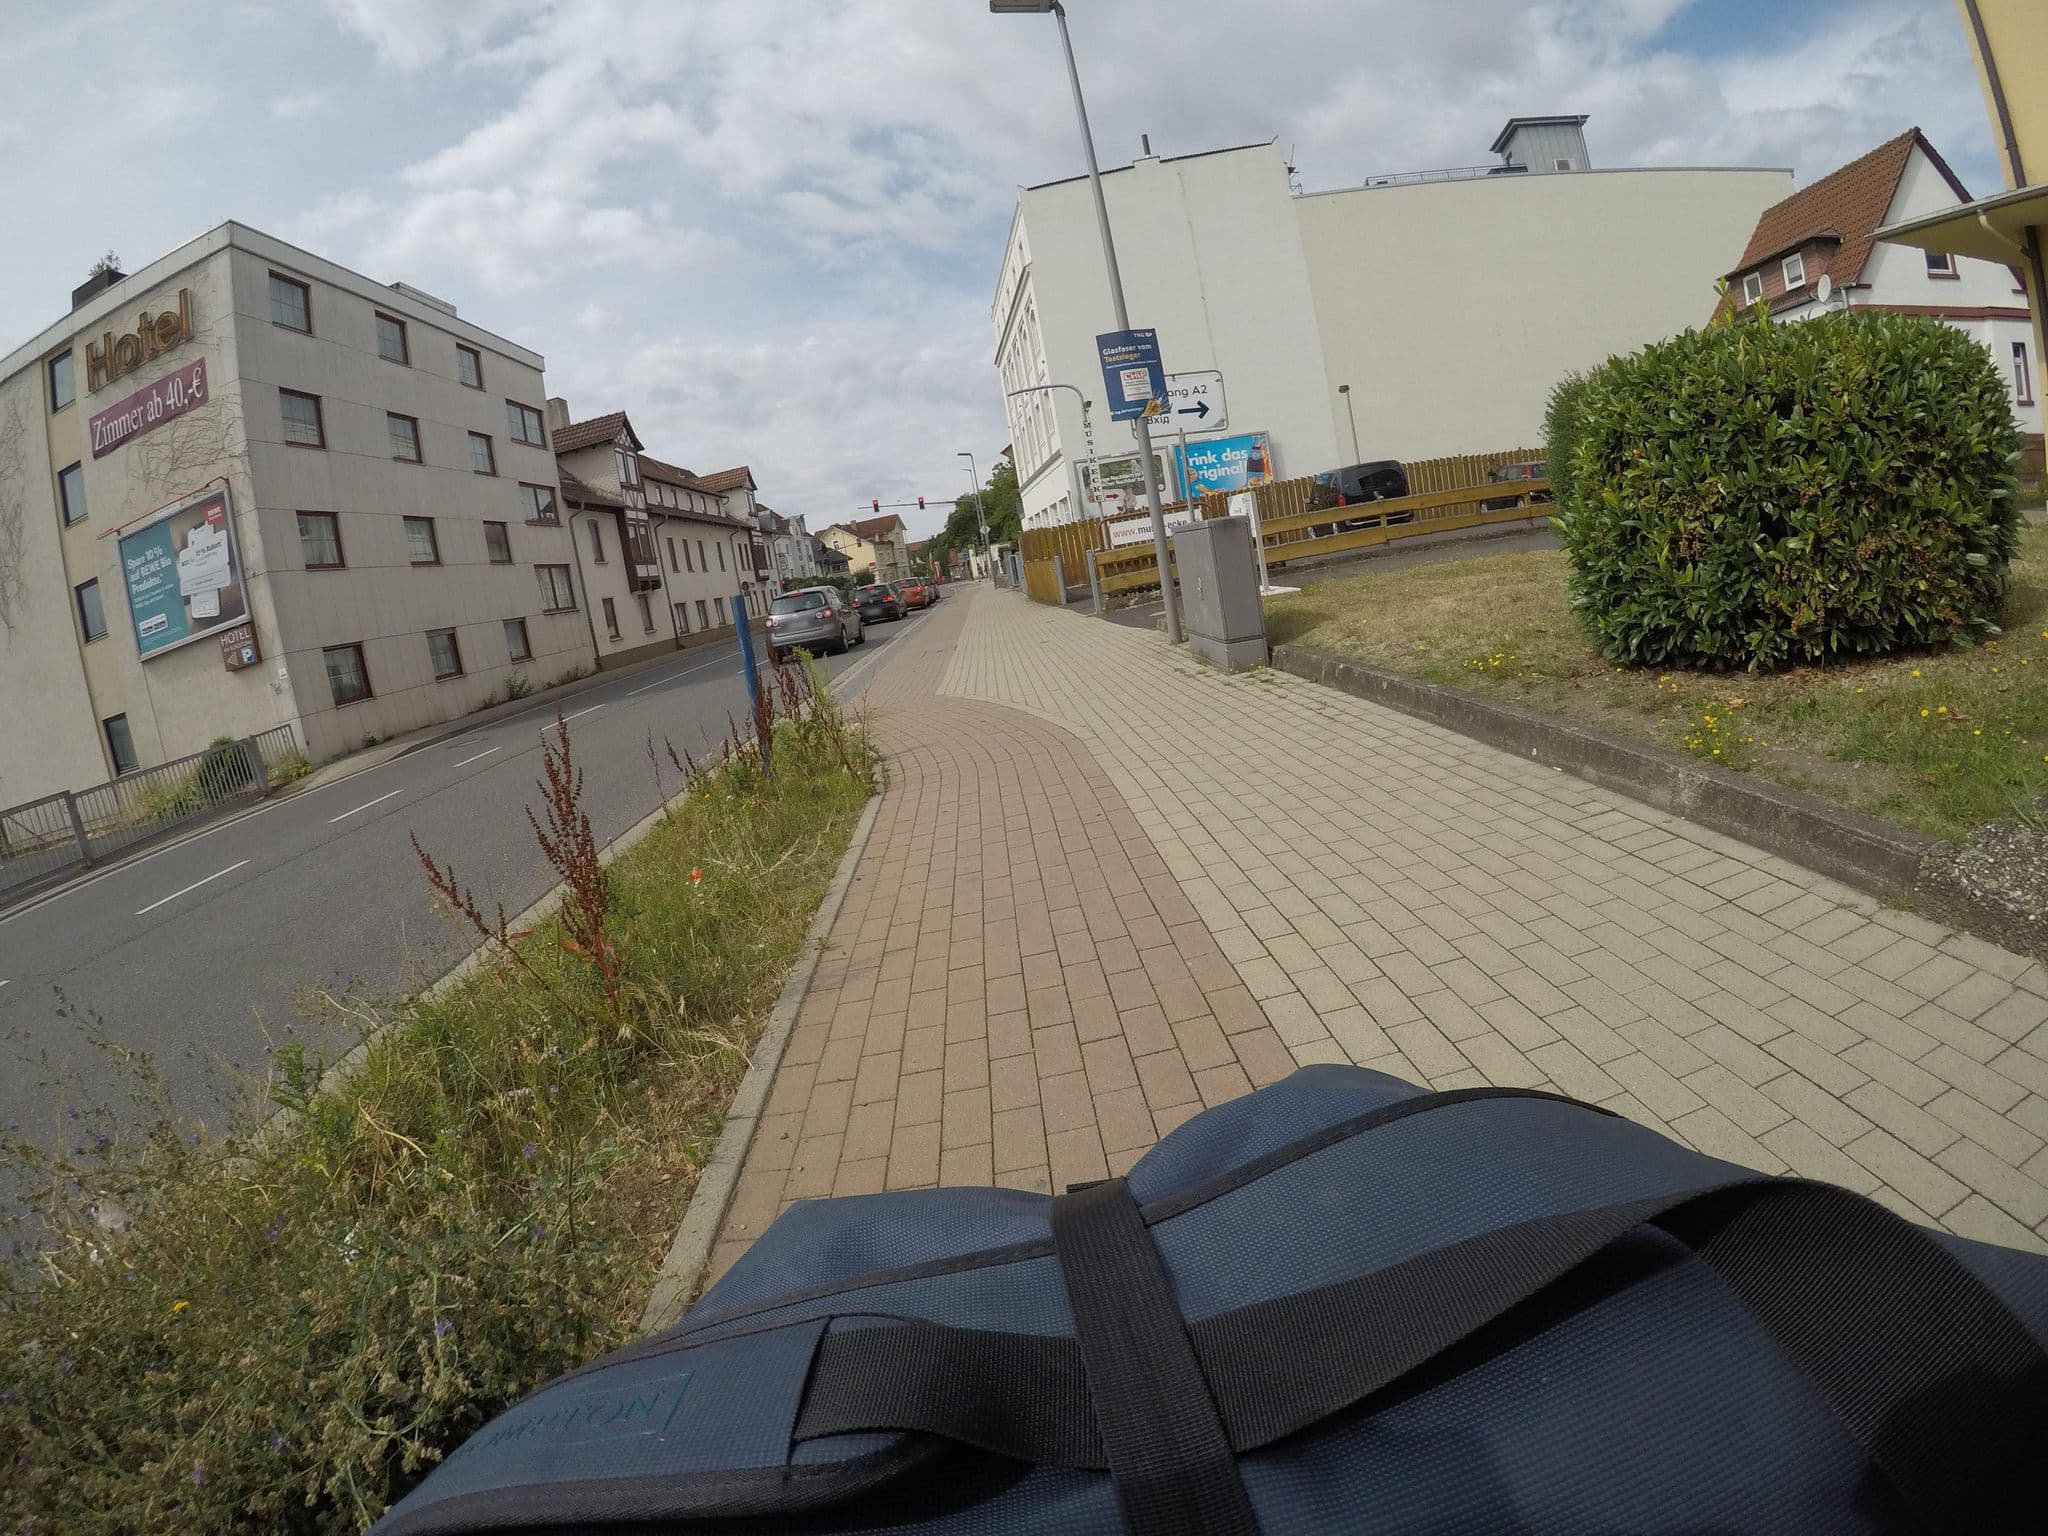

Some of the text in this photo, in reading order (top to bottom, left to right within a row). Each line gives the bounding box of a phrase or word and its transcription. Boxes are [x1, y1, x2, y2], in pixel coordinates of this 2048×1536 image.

[86, 288, 192, 392] Hotel
[1103, 345, 1136, 355] Glasfaser
[1123, 371, 1147, 380] CHIP
[1192, 384, 1208, 394] A2
[93, 405, 144, 450] Zimmer
[147, 389, 163, 422] ab
[1181, 448, 1248, 466] rink das
[220, 627, 250, 646] HOTEL
